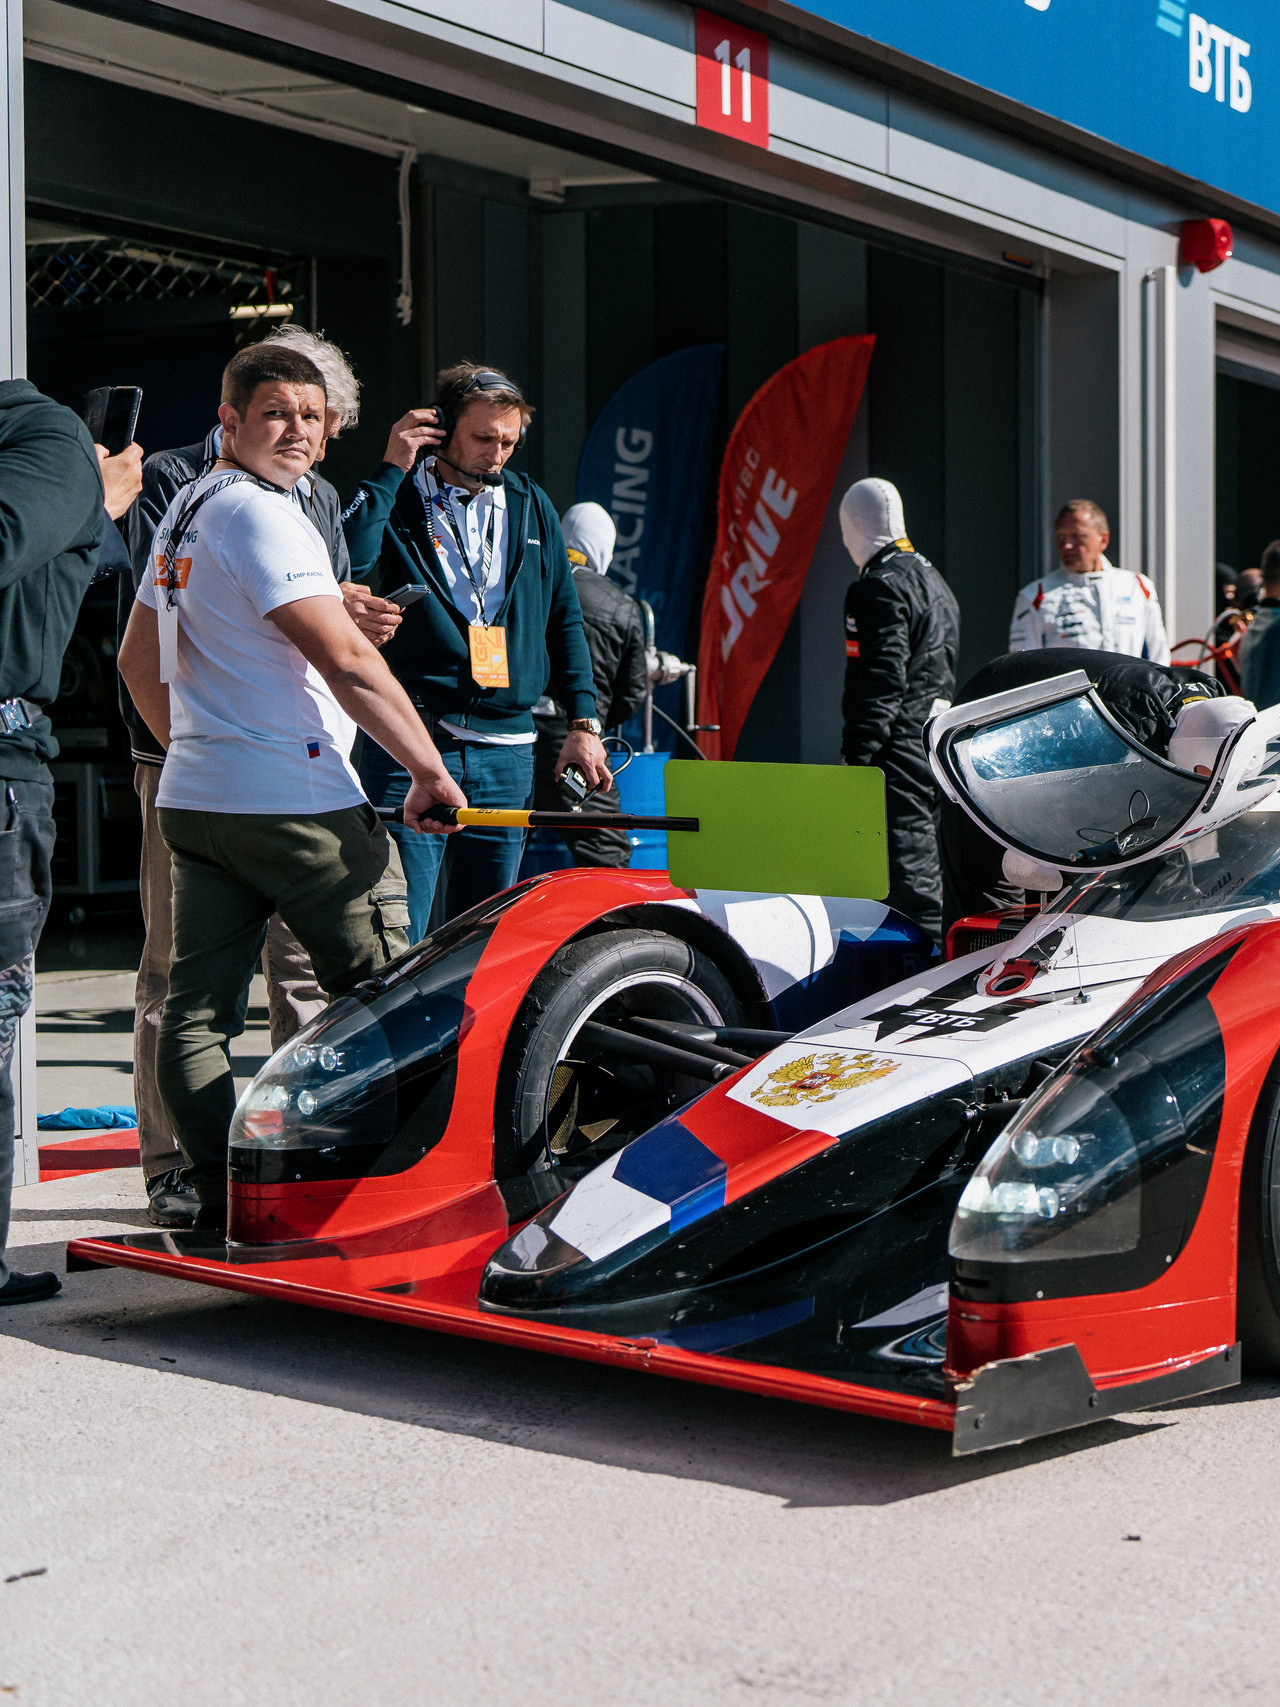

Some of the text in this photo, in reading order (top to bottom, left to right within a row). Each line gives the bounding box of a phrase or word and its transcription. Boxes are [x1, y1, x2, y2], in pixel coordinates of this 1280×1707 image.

[713, 38, 752, 123] 11
[1188, 12, 1252, 114] ВТБ
[916, 1012, 986, 1028] ВТБ
